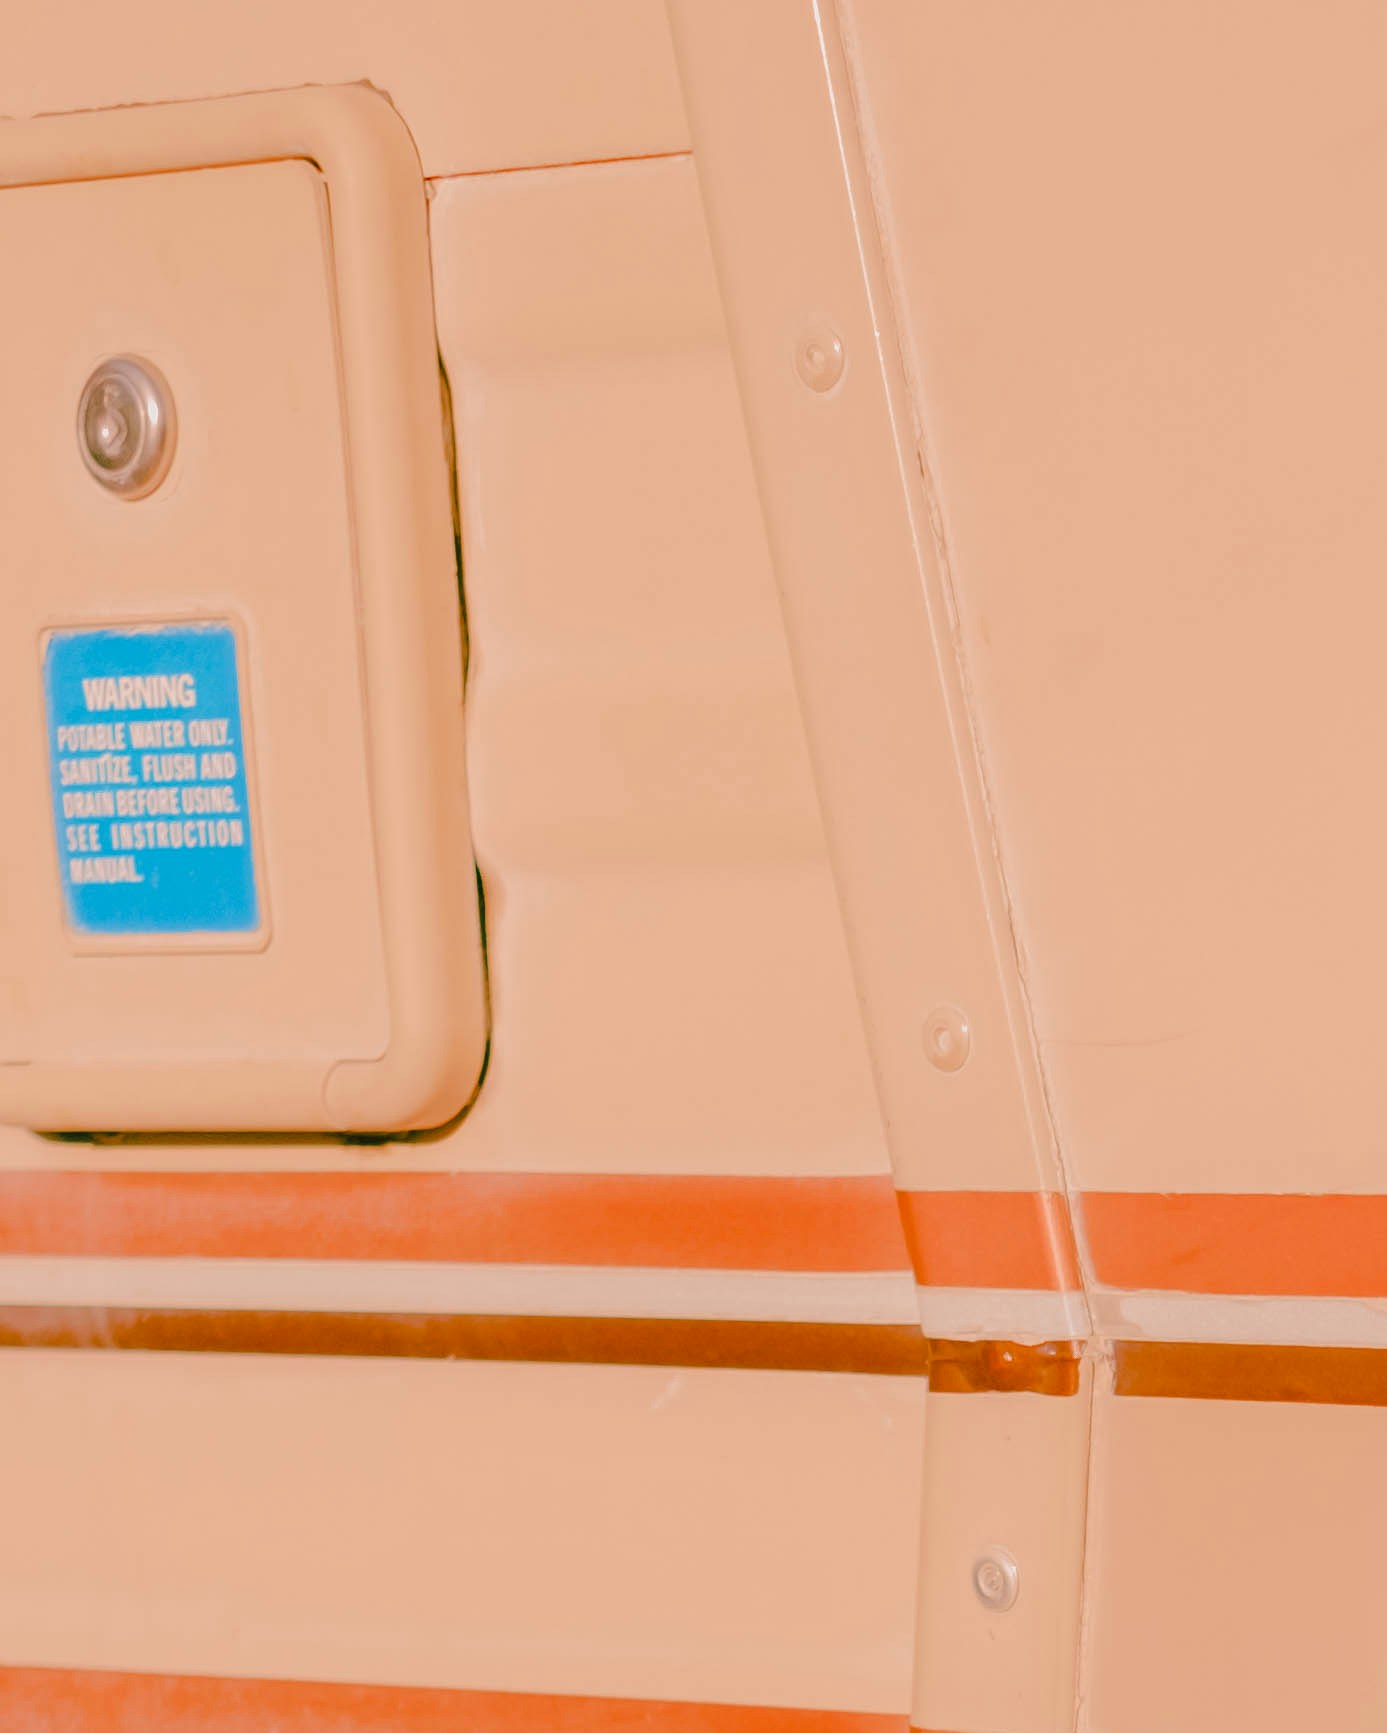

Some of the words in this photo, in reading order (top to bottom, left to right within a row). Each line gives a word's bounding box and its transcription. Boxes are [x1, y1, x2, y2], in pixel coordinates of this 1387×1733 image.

[82, 674, 195, 709] WARNING
[58, 723, 124, 750] POTABLE
[130, 722, 183, 746] WATER
[189, 719, 233, 744] ONLY.
[59, 755, 137, 784] SANITIZE,
[143, 756, 195, 780] FLUSH
[201, 753, 234, 777] AND
[63, 792, 113, 816] DRAIN
[117, 789, 178, 814] BEFORE
[182, 786, 239, 812] USING.
[67, 824, 100, 849] SEE
[111, 820, 242, 847] INSTRUCTION
[70, 857, 143, 881] MANUAL.
